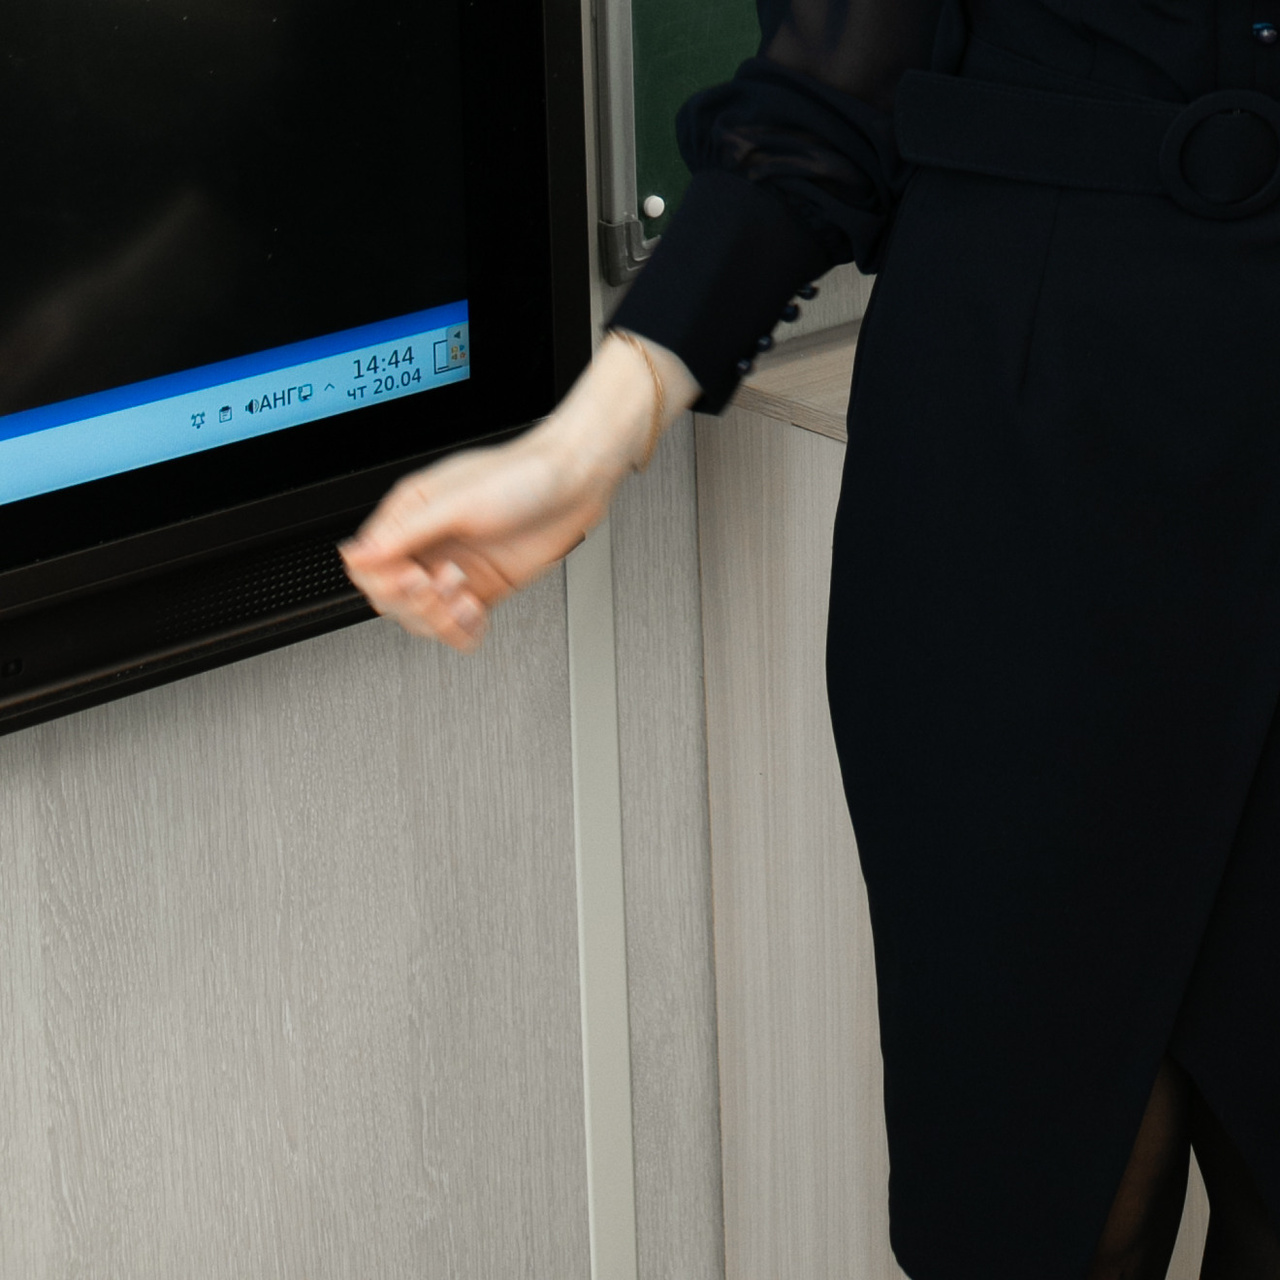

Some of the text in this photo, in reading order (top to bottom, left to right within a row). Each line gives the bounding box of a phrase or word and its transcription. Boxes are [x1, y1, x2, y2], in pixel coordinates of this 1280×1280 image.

[353, 346, 415, 380] 14:44
[259, 386, 298, 413] АНГ
[347, 368, 422, 400] чт 20.04
